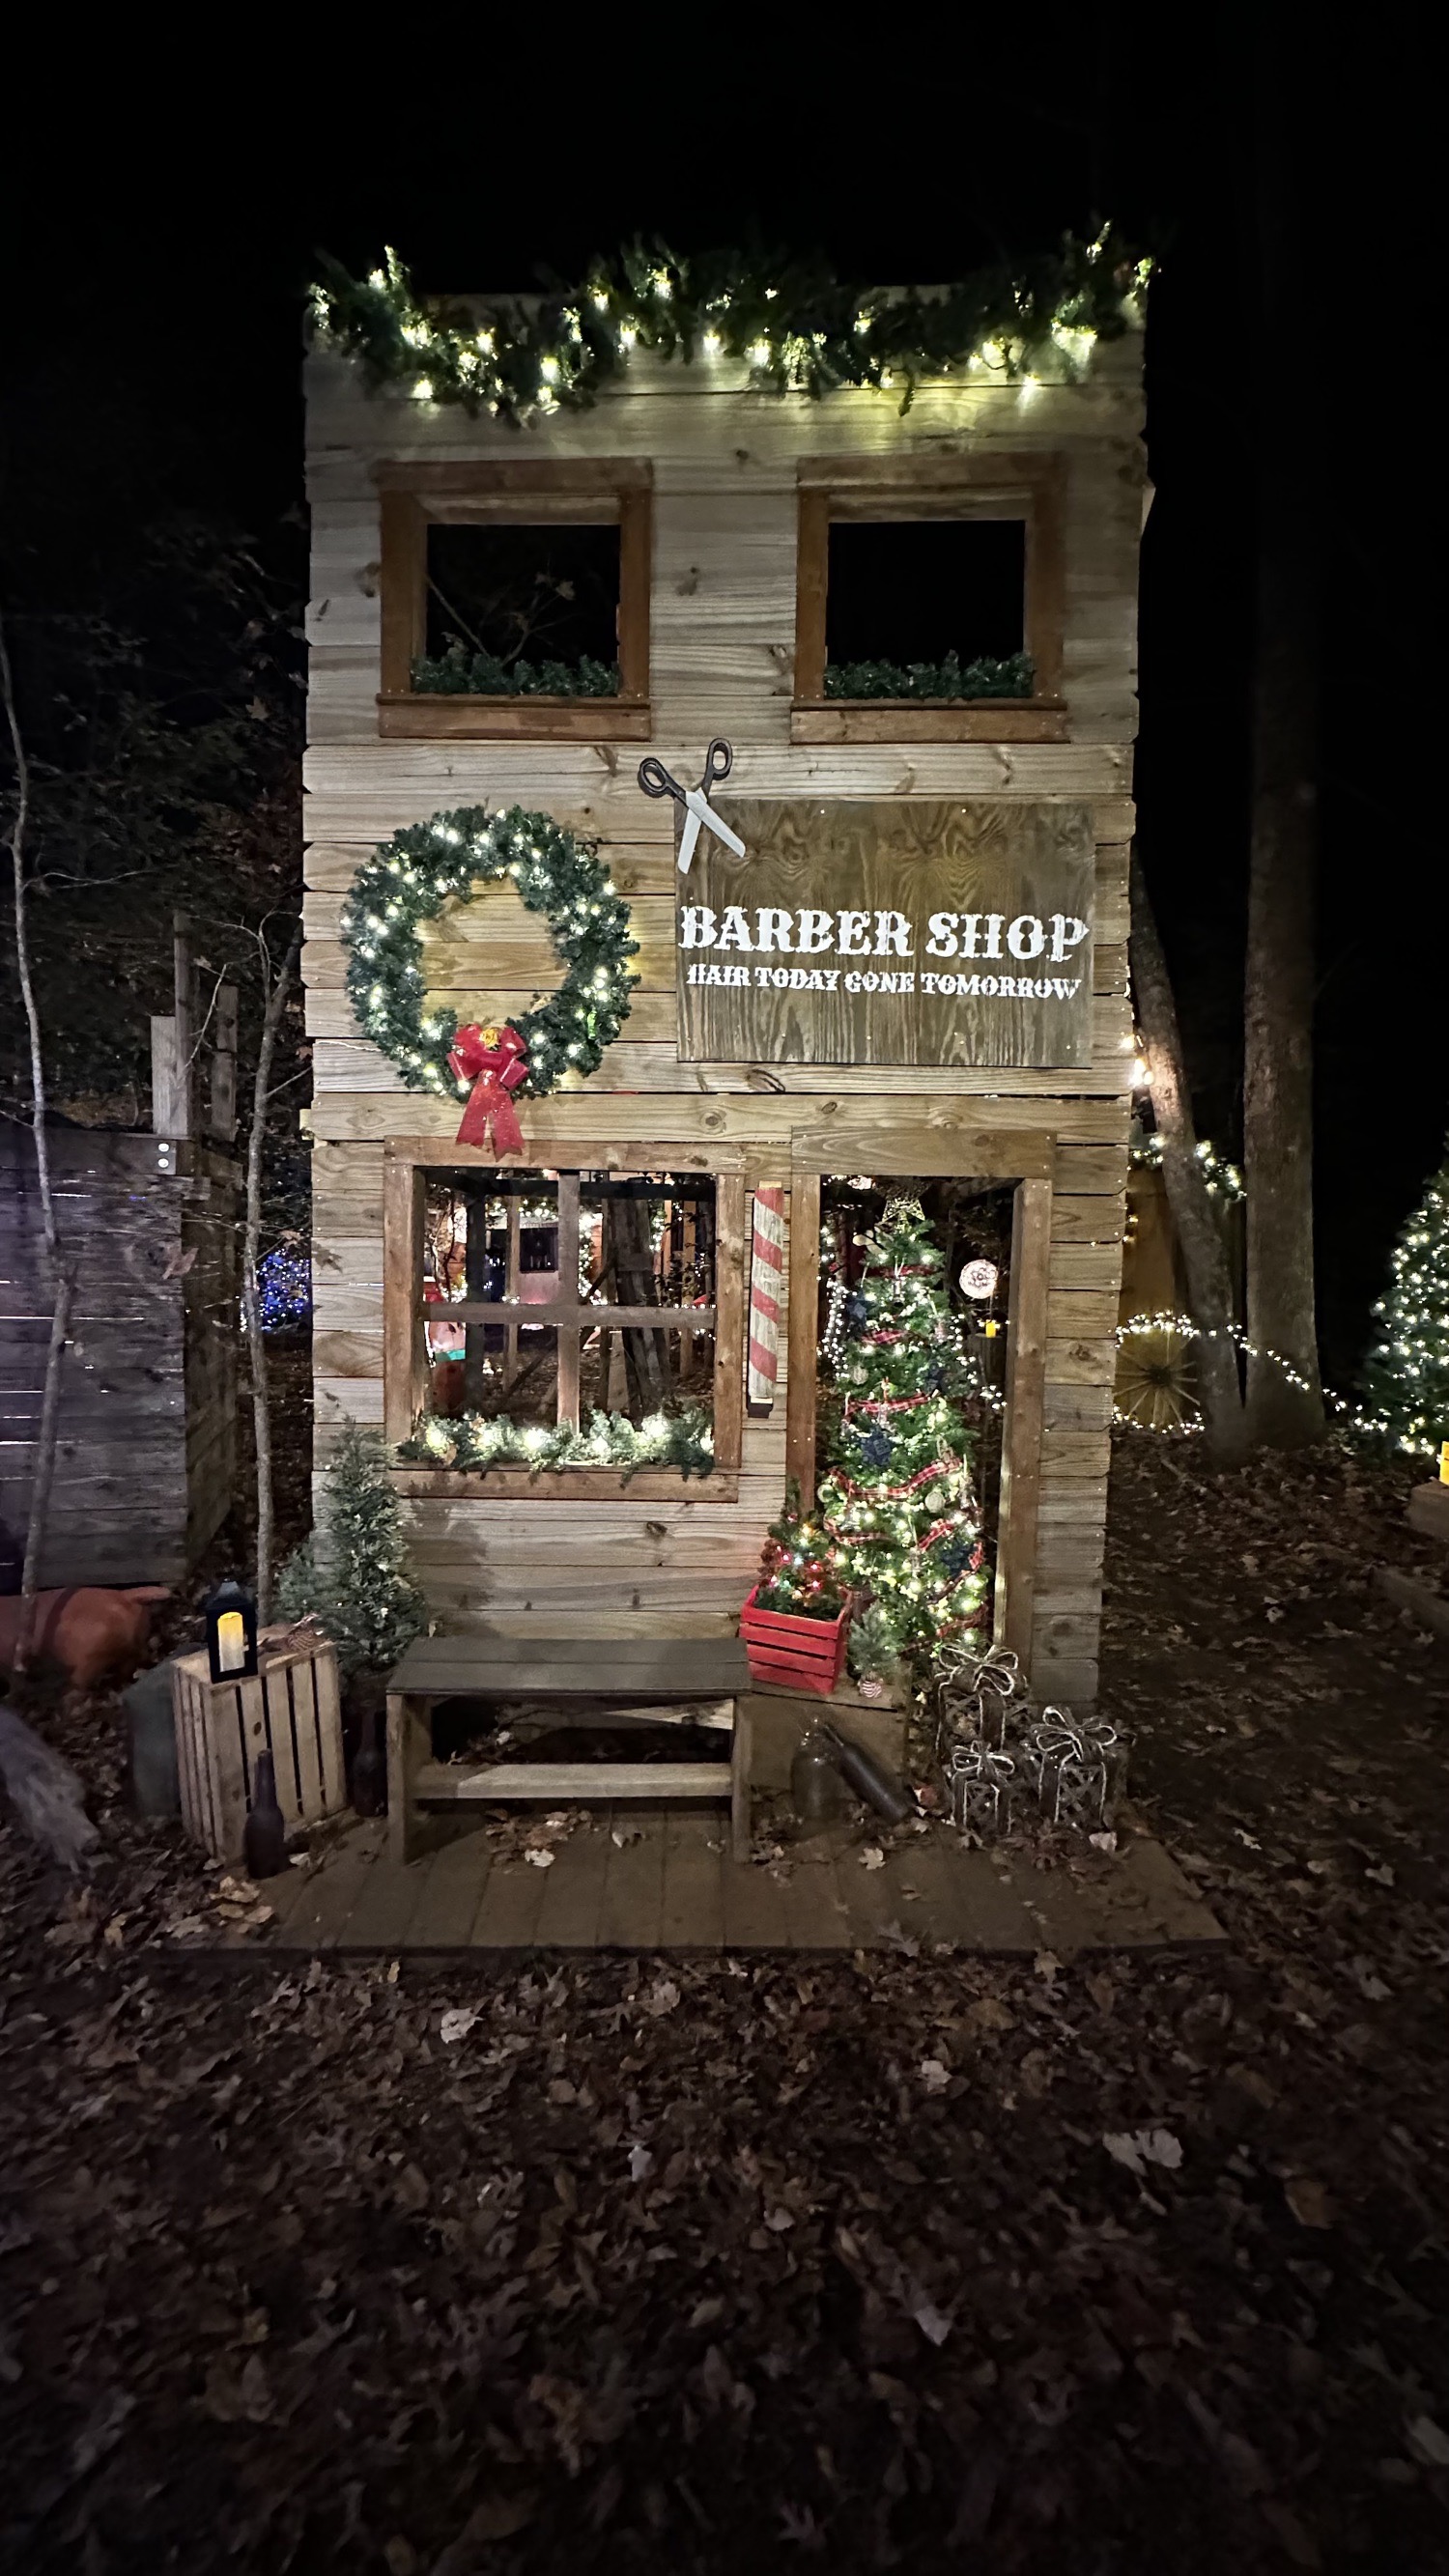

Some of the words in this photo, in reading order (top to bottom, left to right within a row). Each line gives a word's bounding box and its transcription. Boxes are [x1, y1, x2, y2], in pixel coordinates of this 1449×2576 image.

[678, 905, 915, 957] BARBER
[924, 912, 1090, 962] SHOP
[686, 963, 752, 987] HAIR
[754, 966, 841, 991] TODAY
[844, 971, 914, 993] GONE
[920, 972, 1082, 1000] TOMORROW
